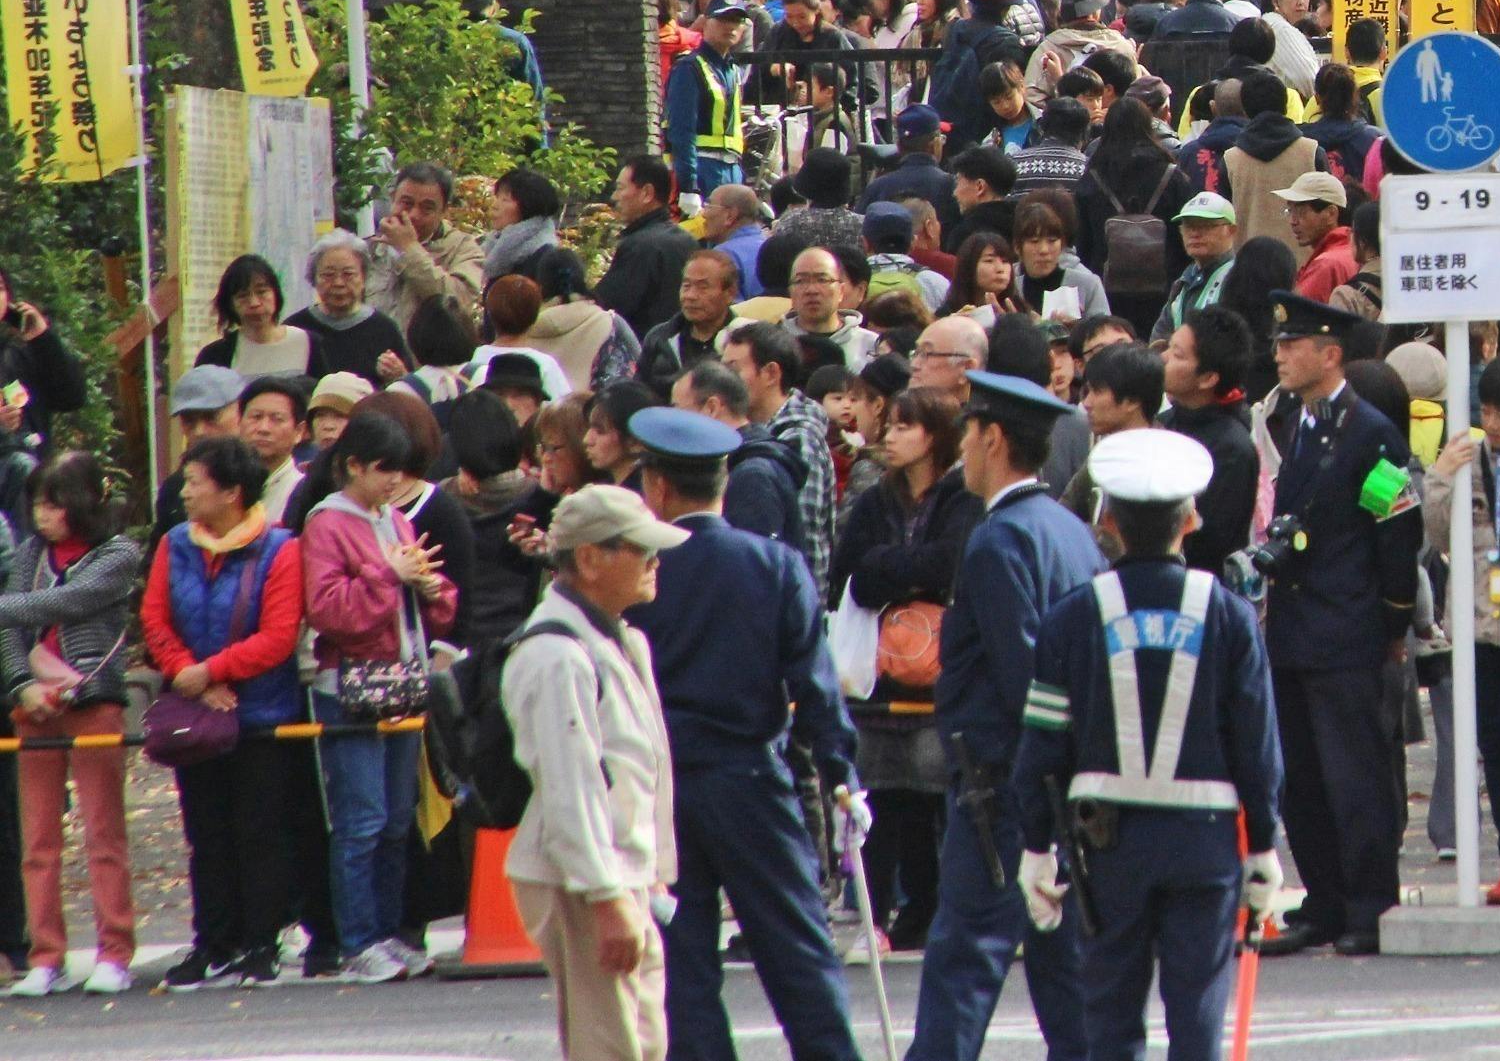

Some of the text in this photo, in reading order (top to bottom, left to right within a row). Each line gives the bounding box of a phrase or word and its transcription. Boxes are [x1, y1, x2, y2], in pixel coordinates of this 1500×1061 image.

[1400, 255, 1467, 272] 居住者用
[1400, 275, 1479, 291] 車両を除く
